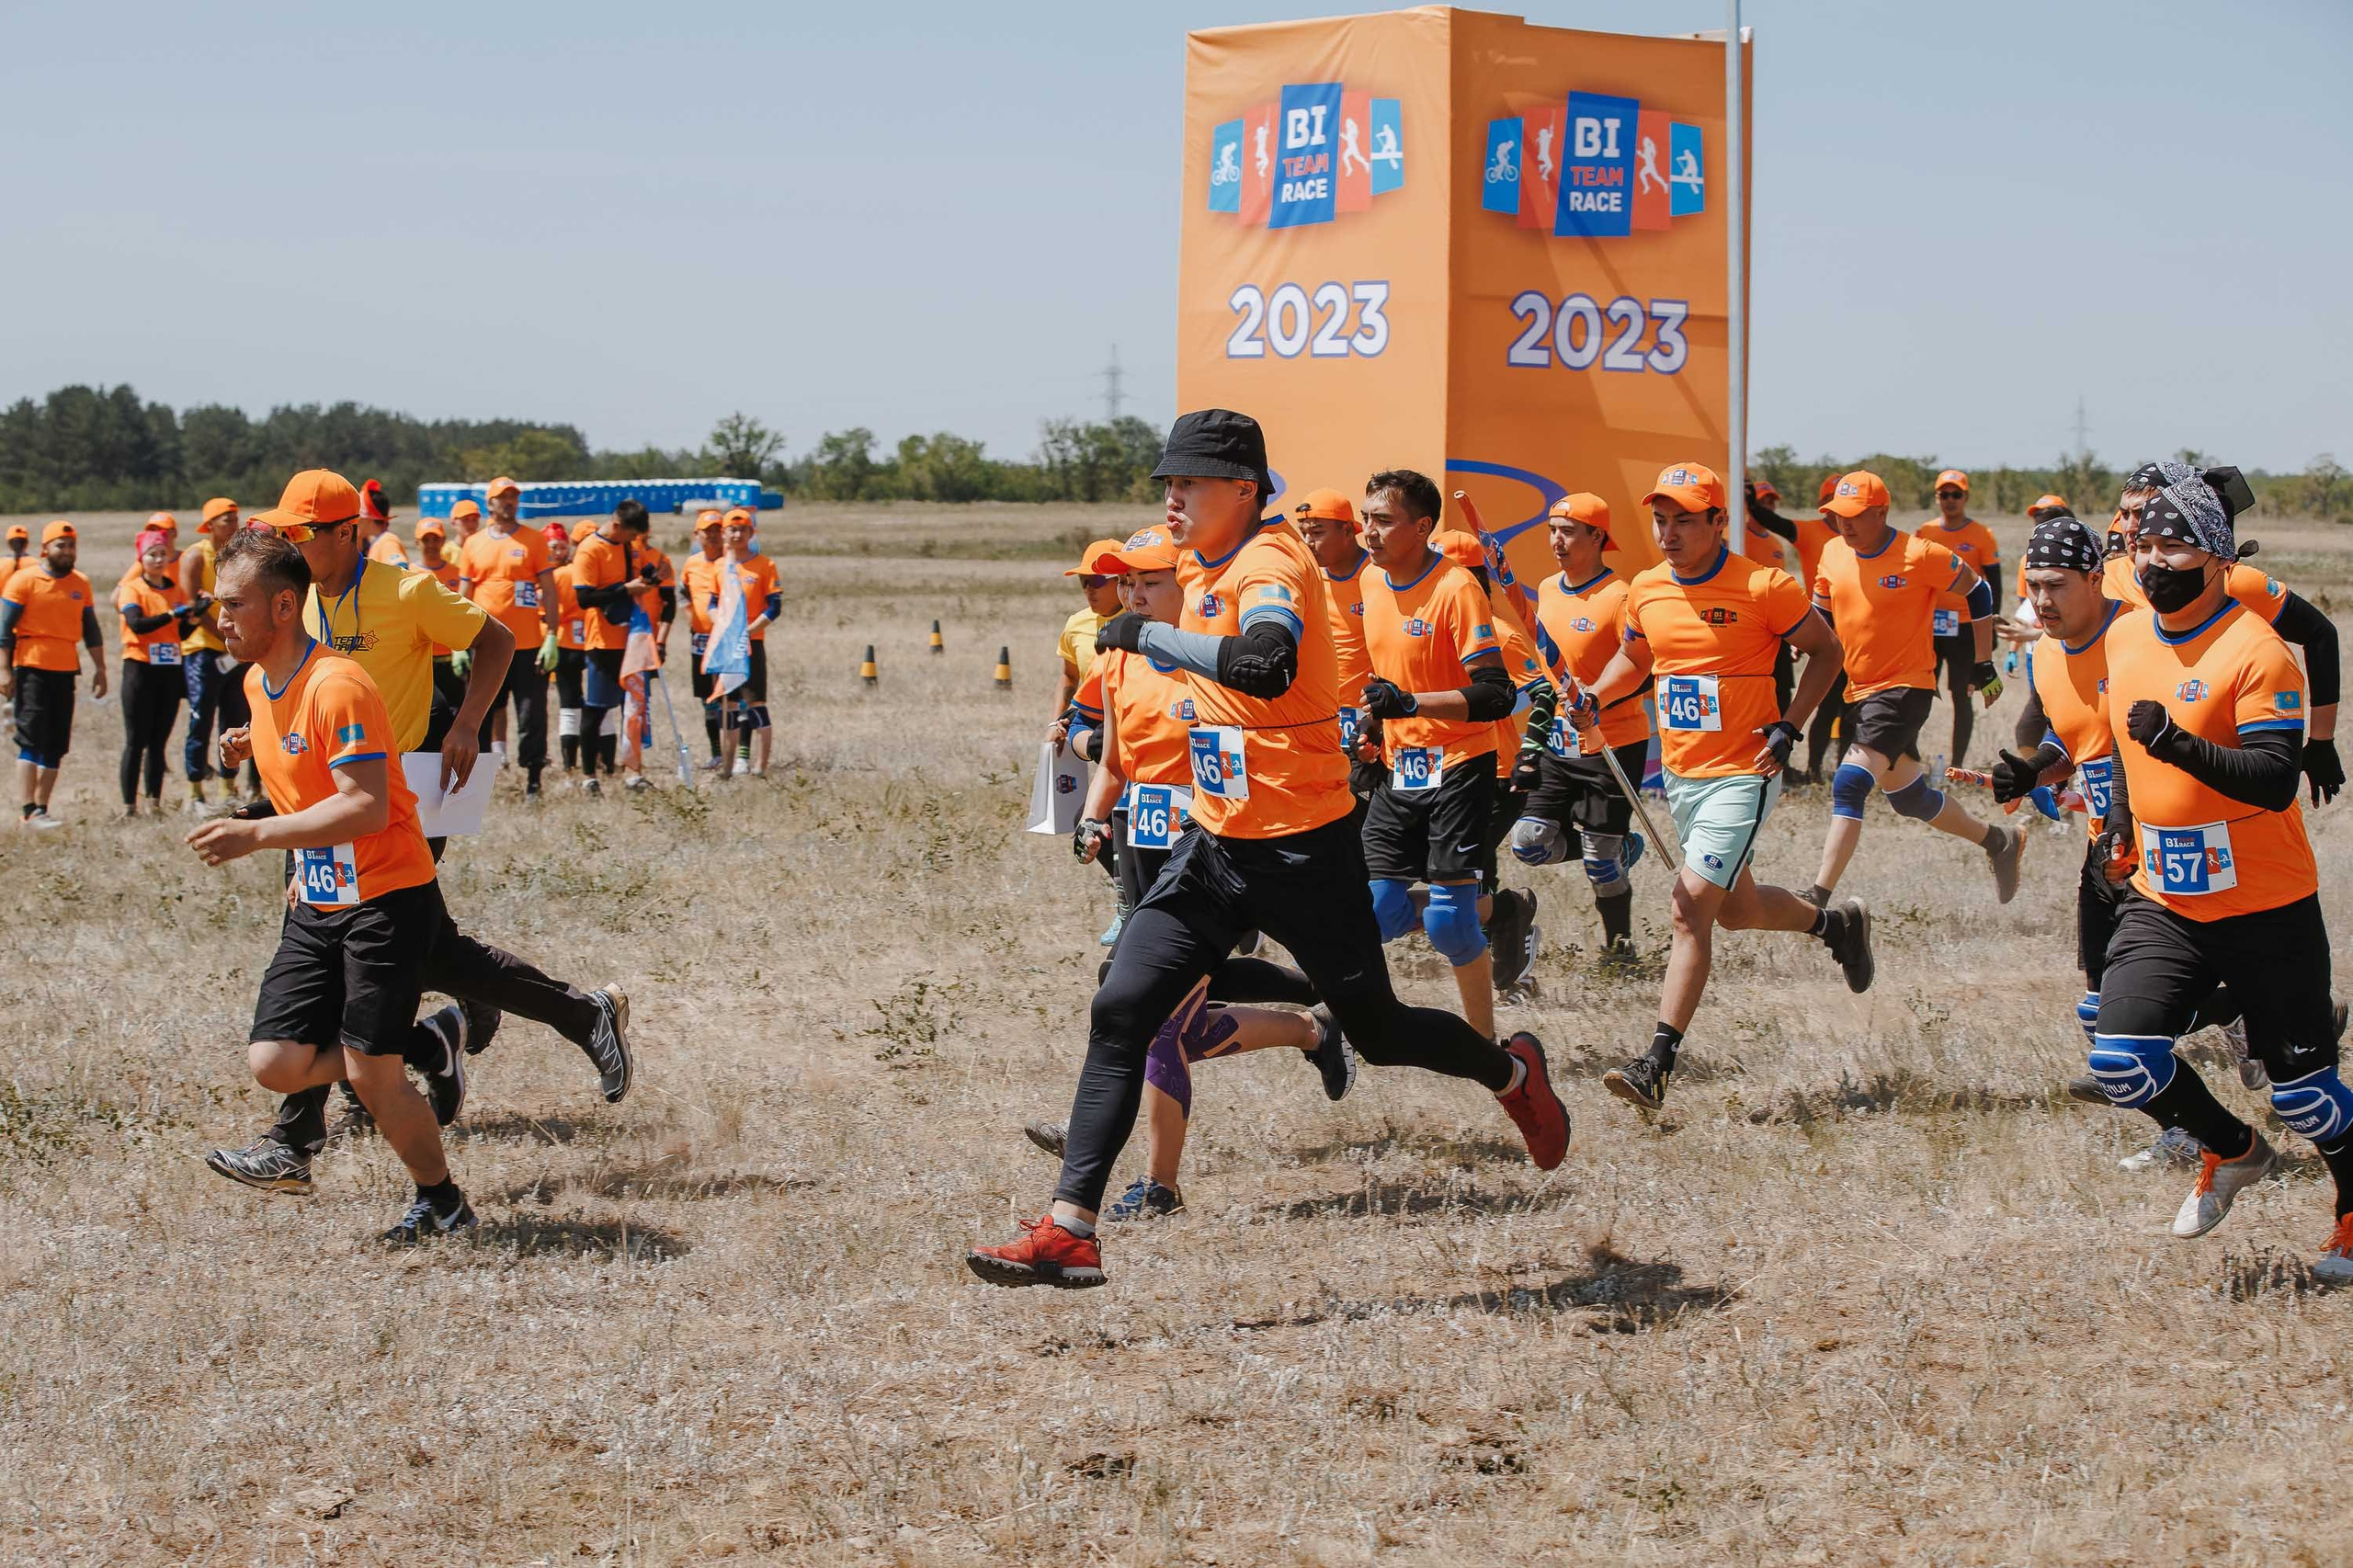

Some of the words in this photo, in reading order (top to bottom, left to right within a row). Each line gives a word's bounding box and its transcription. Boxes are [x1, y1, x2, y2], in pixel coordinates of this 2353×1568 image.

[1287, 105, 1327, 149] BI
[1574, 117, 1621, 158] BI
[1282, 153, 1329, 177] TEAM
[1570, 165, 1624, 187] TEAM
[1281, 178, 1328, 203] RACE
[1569, 190, 1622, 212] RACE
[1226, 280, 1390, 359] 2023
[1506, 290, 1688, 375] 2023
[1671, 697, 1699, 722] 46
[1194, 752, 1222, 785] 46
[1404, 756, 1427, 779] 46
[1141, 793, 1150, 803] BI
[2090, 780, 2112, 808] 57
[1137, 808, 1167, 837] 46
[306, 850, 315, 859] BI
[2165, 837, 2178, 847] BI
[308, 865, 336, 892] 46
[2165, 852, 2202, 882] 57
